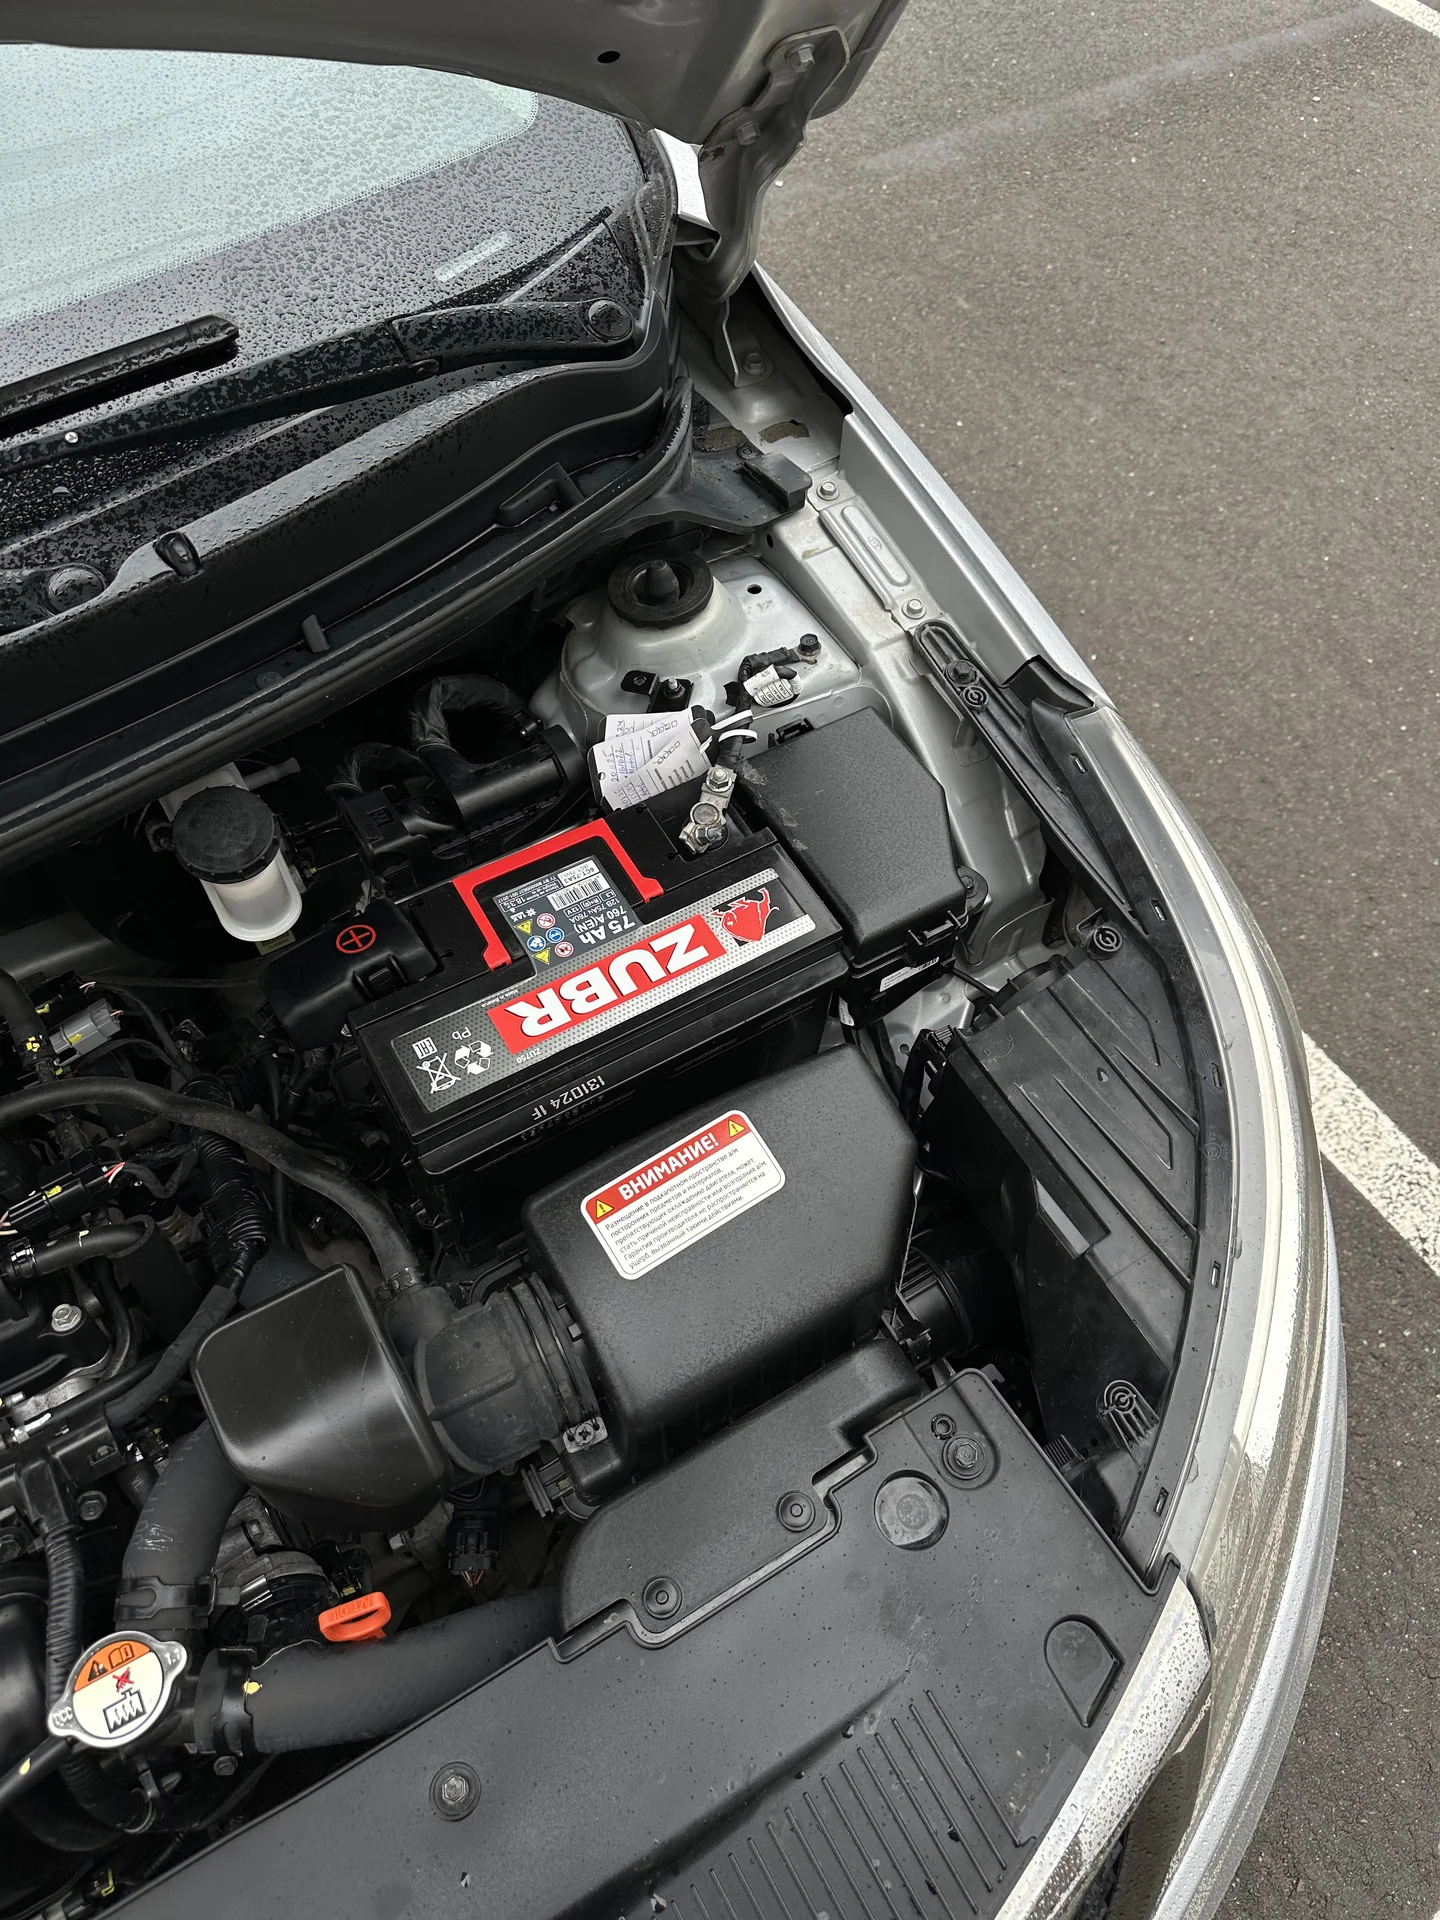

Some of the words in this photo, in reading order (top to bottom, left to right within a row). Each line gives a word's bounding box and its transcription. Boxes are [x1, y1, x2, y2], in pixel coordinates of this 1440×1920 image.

[572, 911, 605, 934] A(EN)
[605, 904, 626, 919] 760
[607, 912, 635, 935] 75
[578, 924, 607, 948] Ah
[504, 924, 708, 1038] ZUBR
[449, 1025, 471, 1042] Pb
[546, 1073, 605, 1110] 131024
[616, 1131, 719, 1201] ВНИМАНИЕ!
